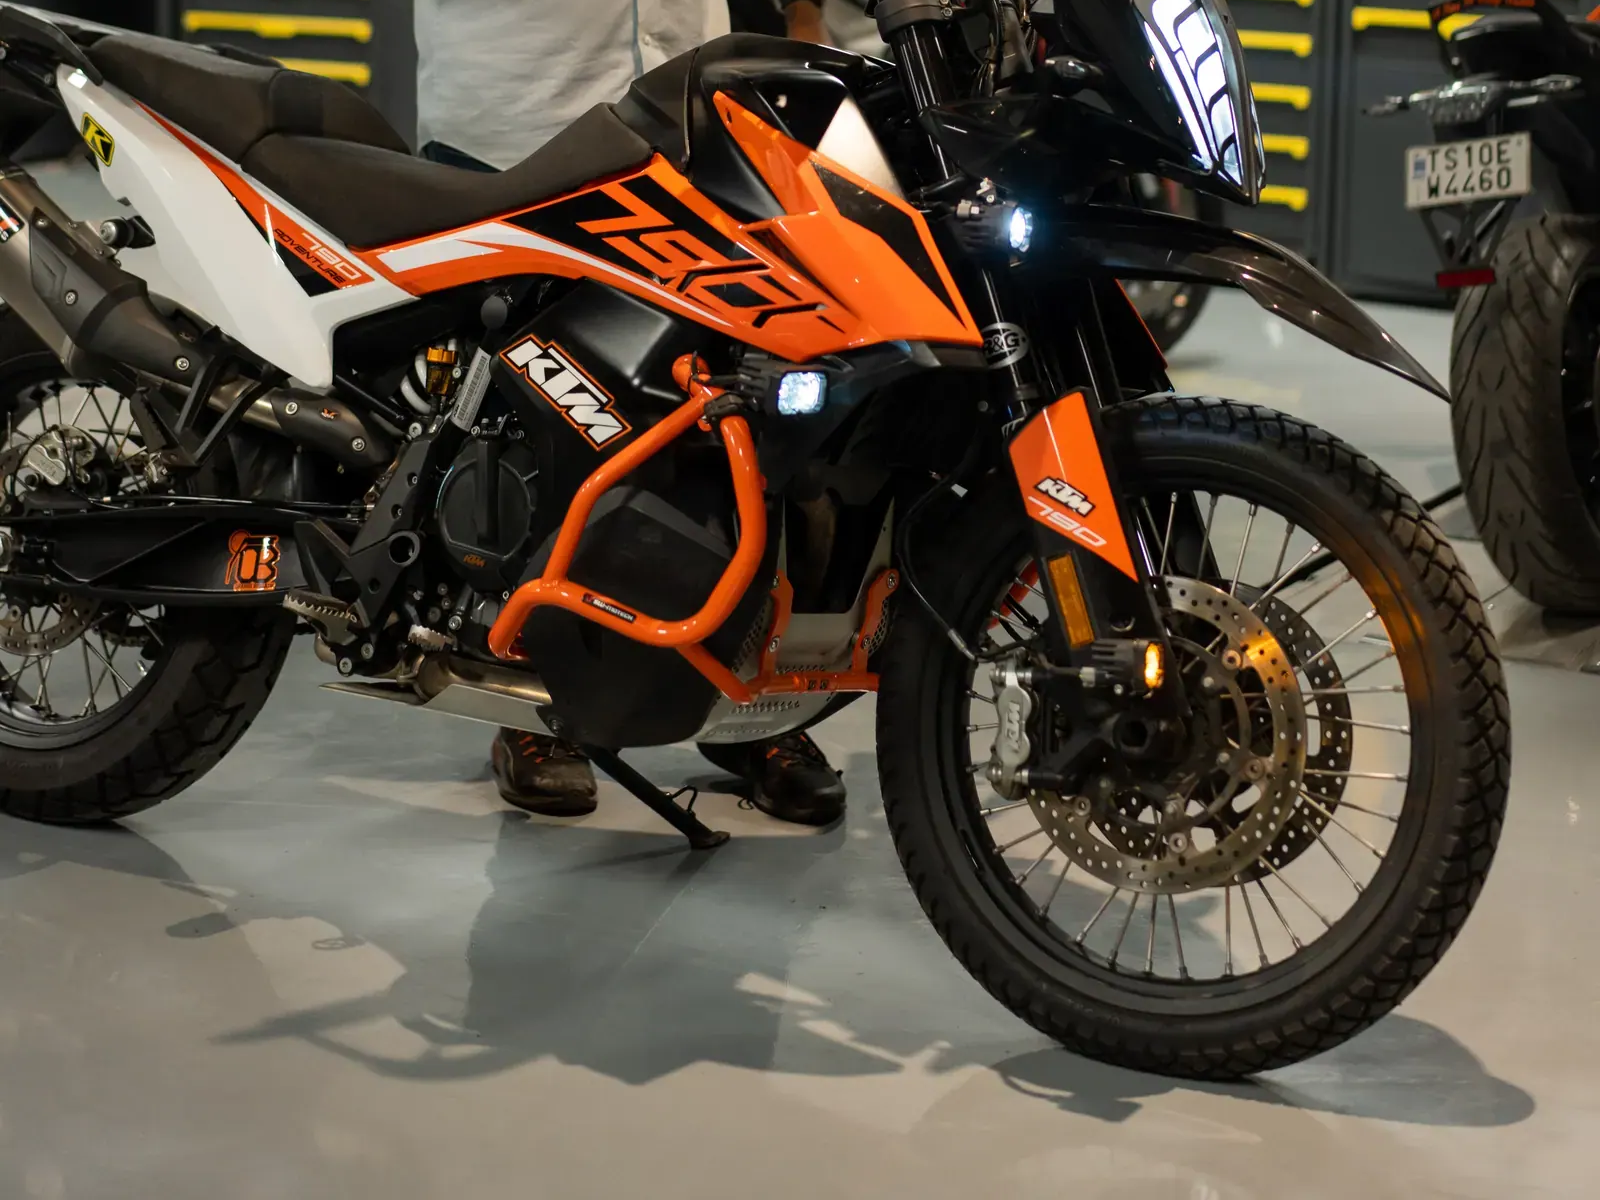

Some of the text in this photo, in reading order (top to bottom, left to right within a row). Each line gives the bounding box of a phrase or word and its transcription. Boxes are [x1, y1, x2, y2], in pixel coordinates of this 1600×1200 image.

[1427, 139, 1511, 173] TS10E
[1427, 167, 1511, 199] W4460
[274, 228, 347, 285] ADVENTURE
[302, 232, 362, 281] 790
[505, 339, 624, 445] KTM
[1036, 477, 1094, 516] KTM
[1027, 495, 1108, 548] 790
